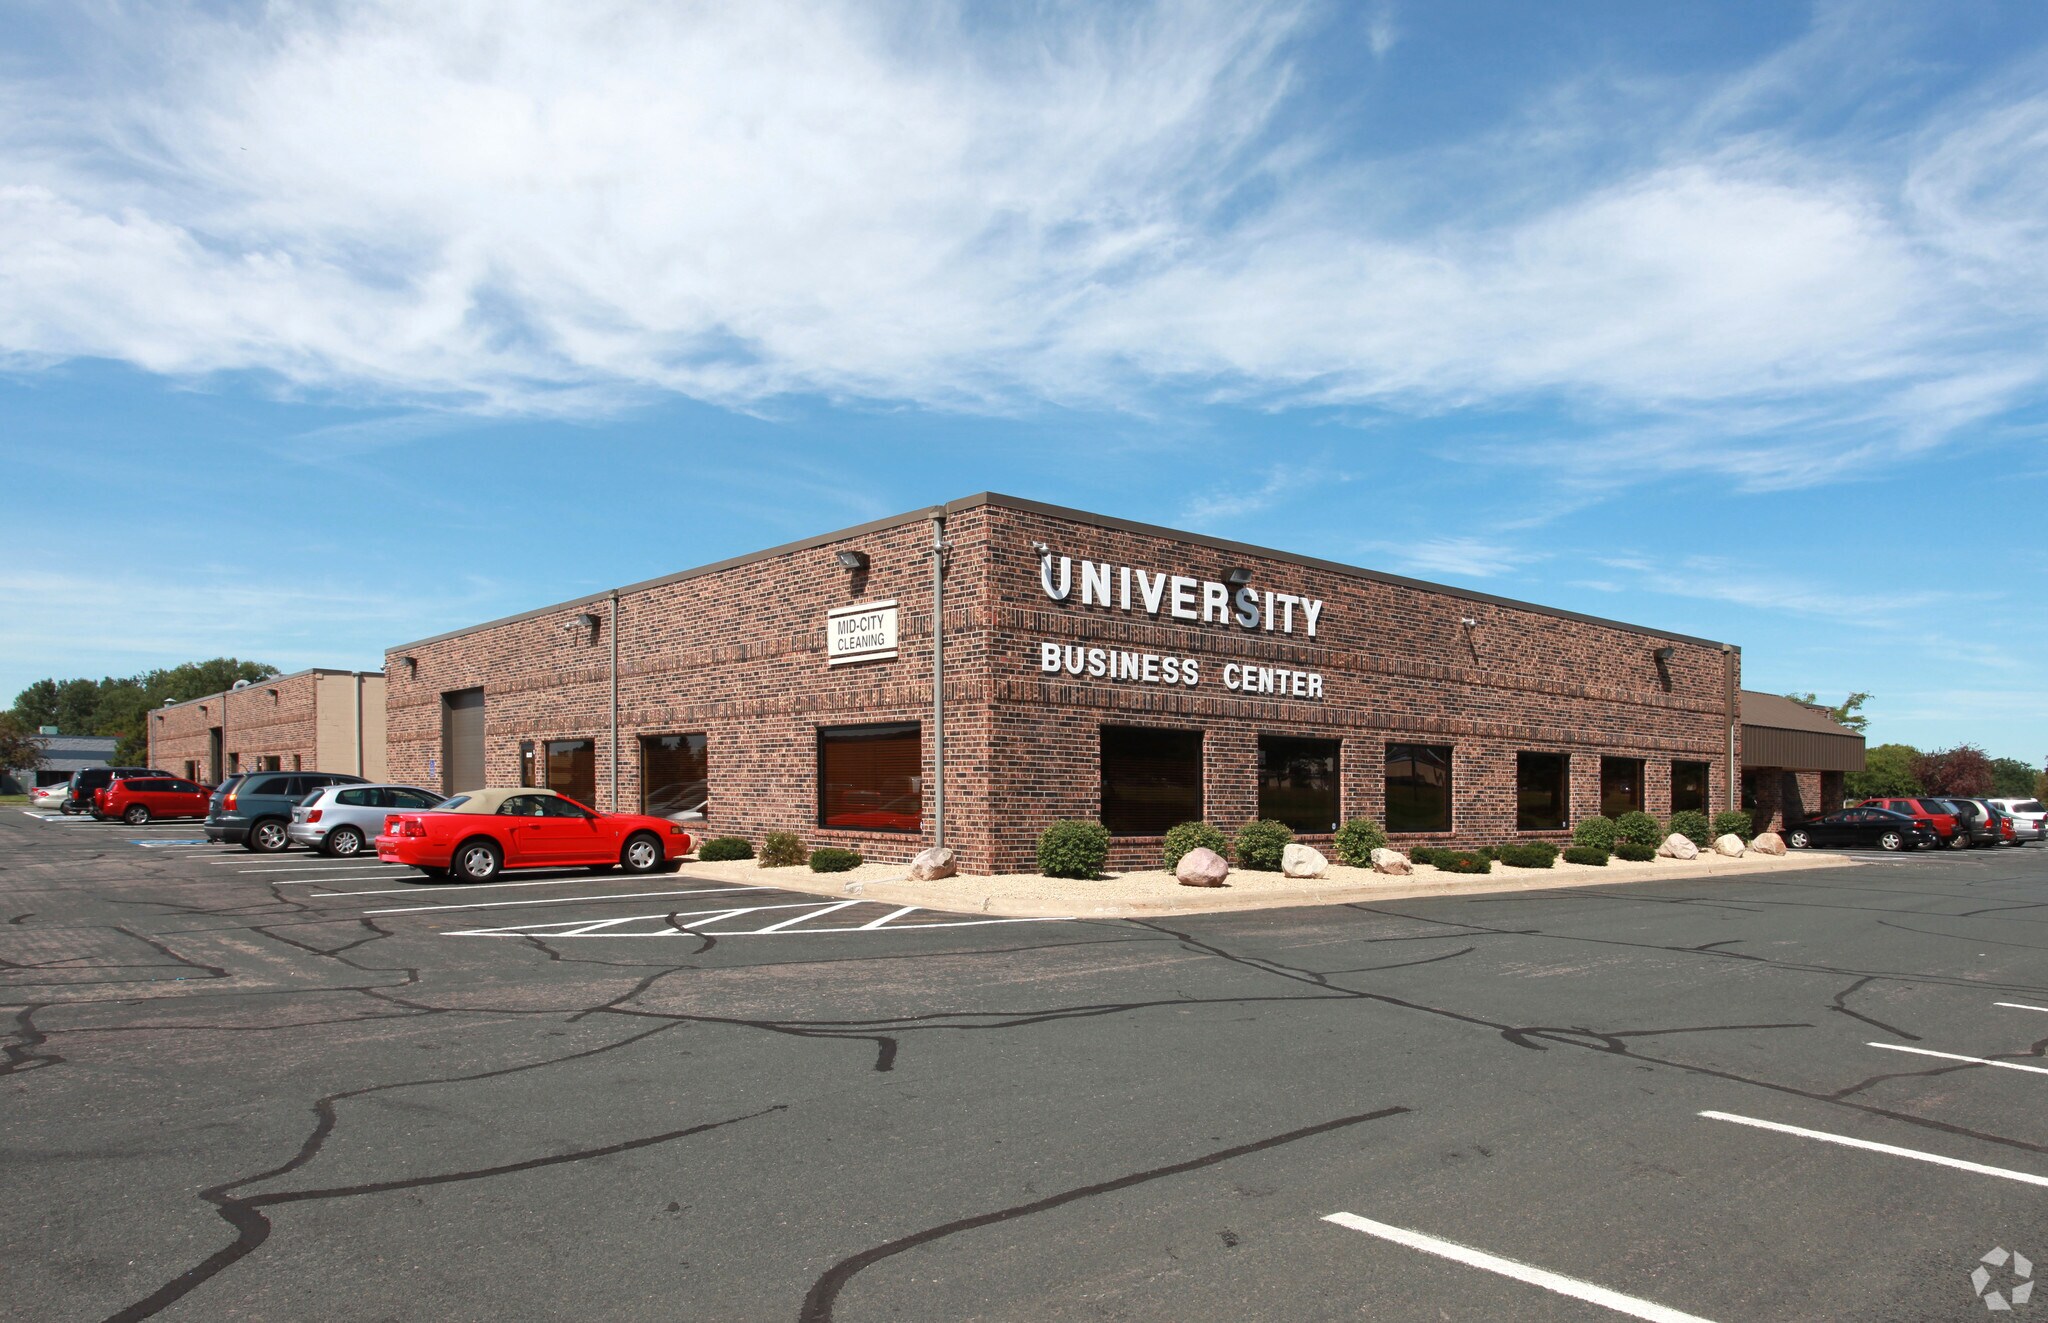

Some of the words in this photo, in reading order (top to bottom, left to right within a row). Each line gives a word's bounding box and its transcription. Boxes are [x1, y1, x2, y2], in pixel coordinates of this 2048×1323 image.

[1041, 552, 1323, 636] UNIVERSITY
[837, 614, 884, 635] MID-CITY
[837, 632, 885, 651] CLEANING
[1041, 642, 1199, 685] BUSINESS
[1223, 663, 1323, 698] CENTER
